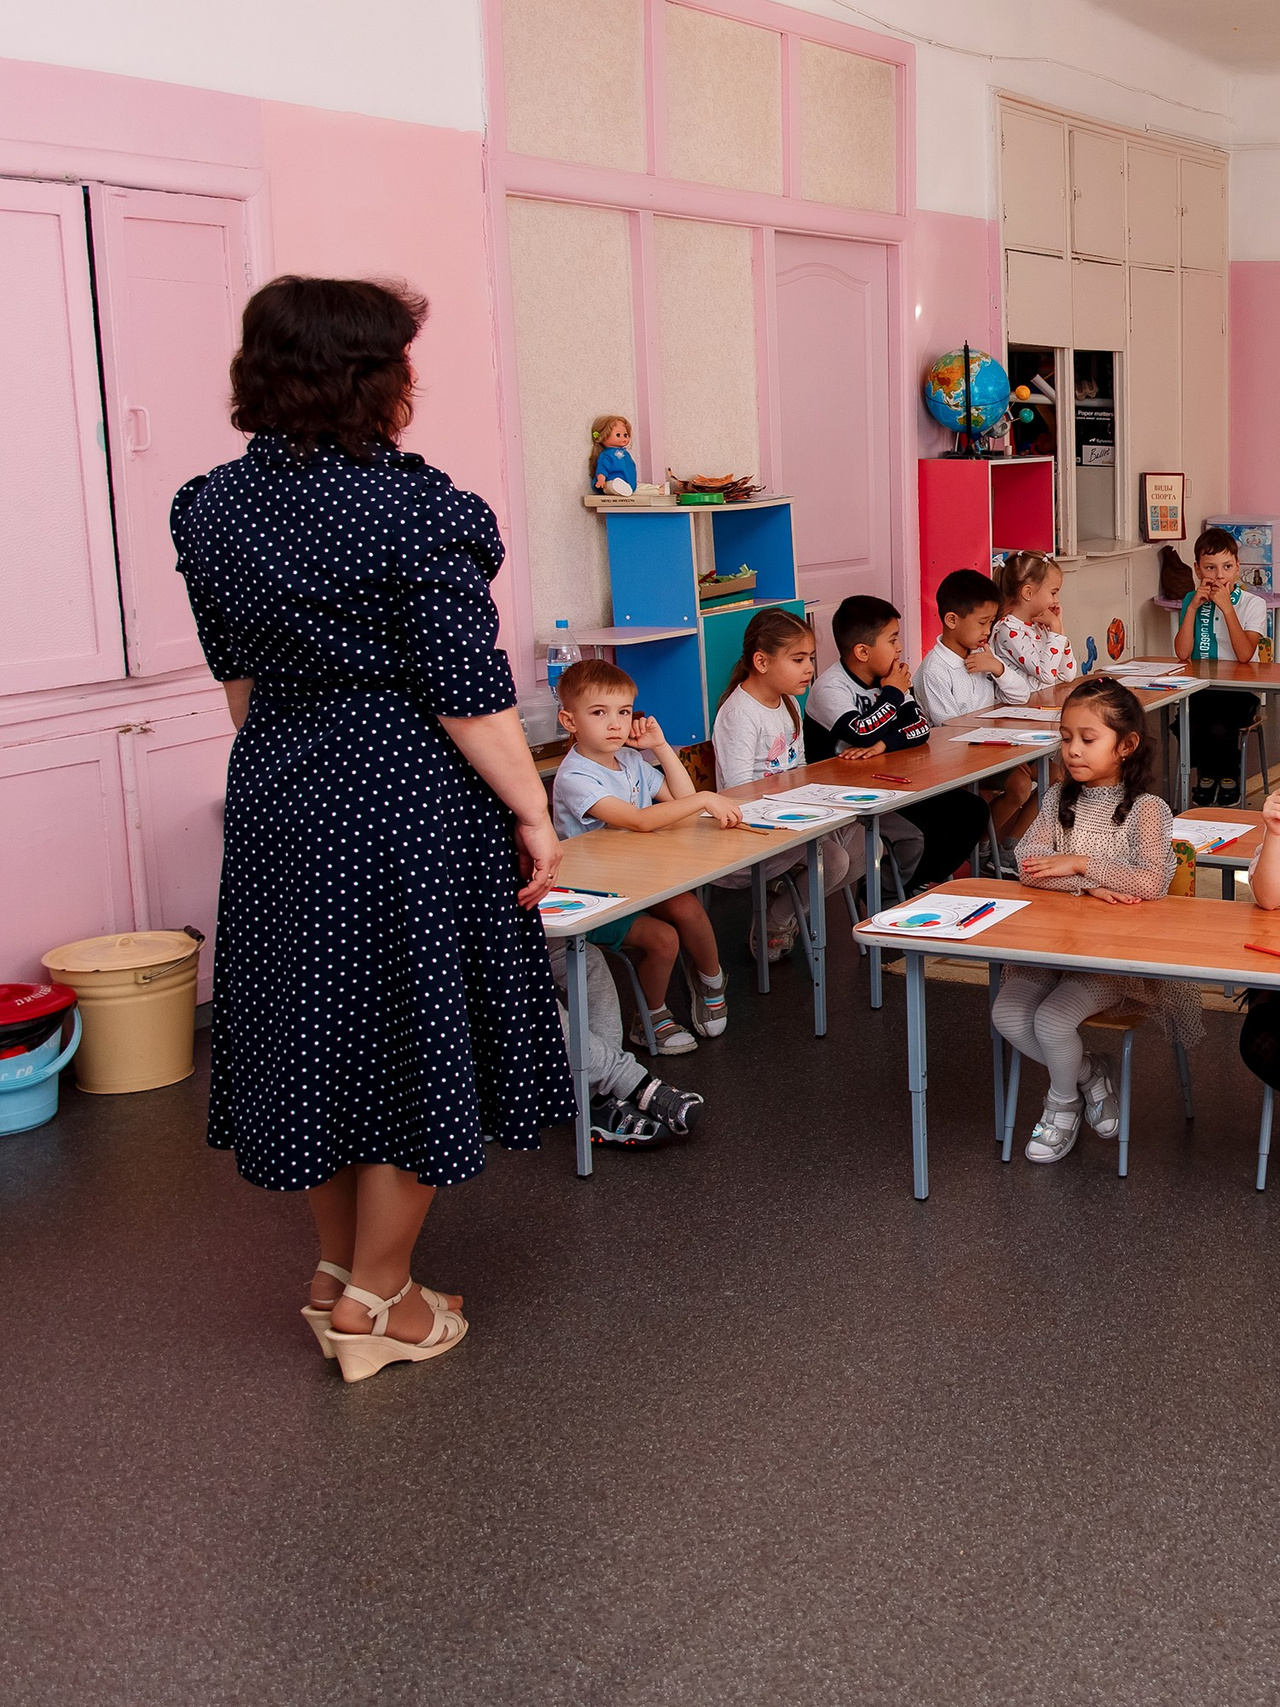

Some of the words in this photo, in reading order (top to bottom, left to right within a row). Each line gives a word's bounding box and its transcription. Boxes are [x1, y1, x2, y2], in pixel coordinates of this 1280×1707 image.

[1154, 484, 1173, 492] ВИДЫ
[1150, 493, 1177, 501] СПОРТА
[1199, 618, 1211, 651] PLUGGED
